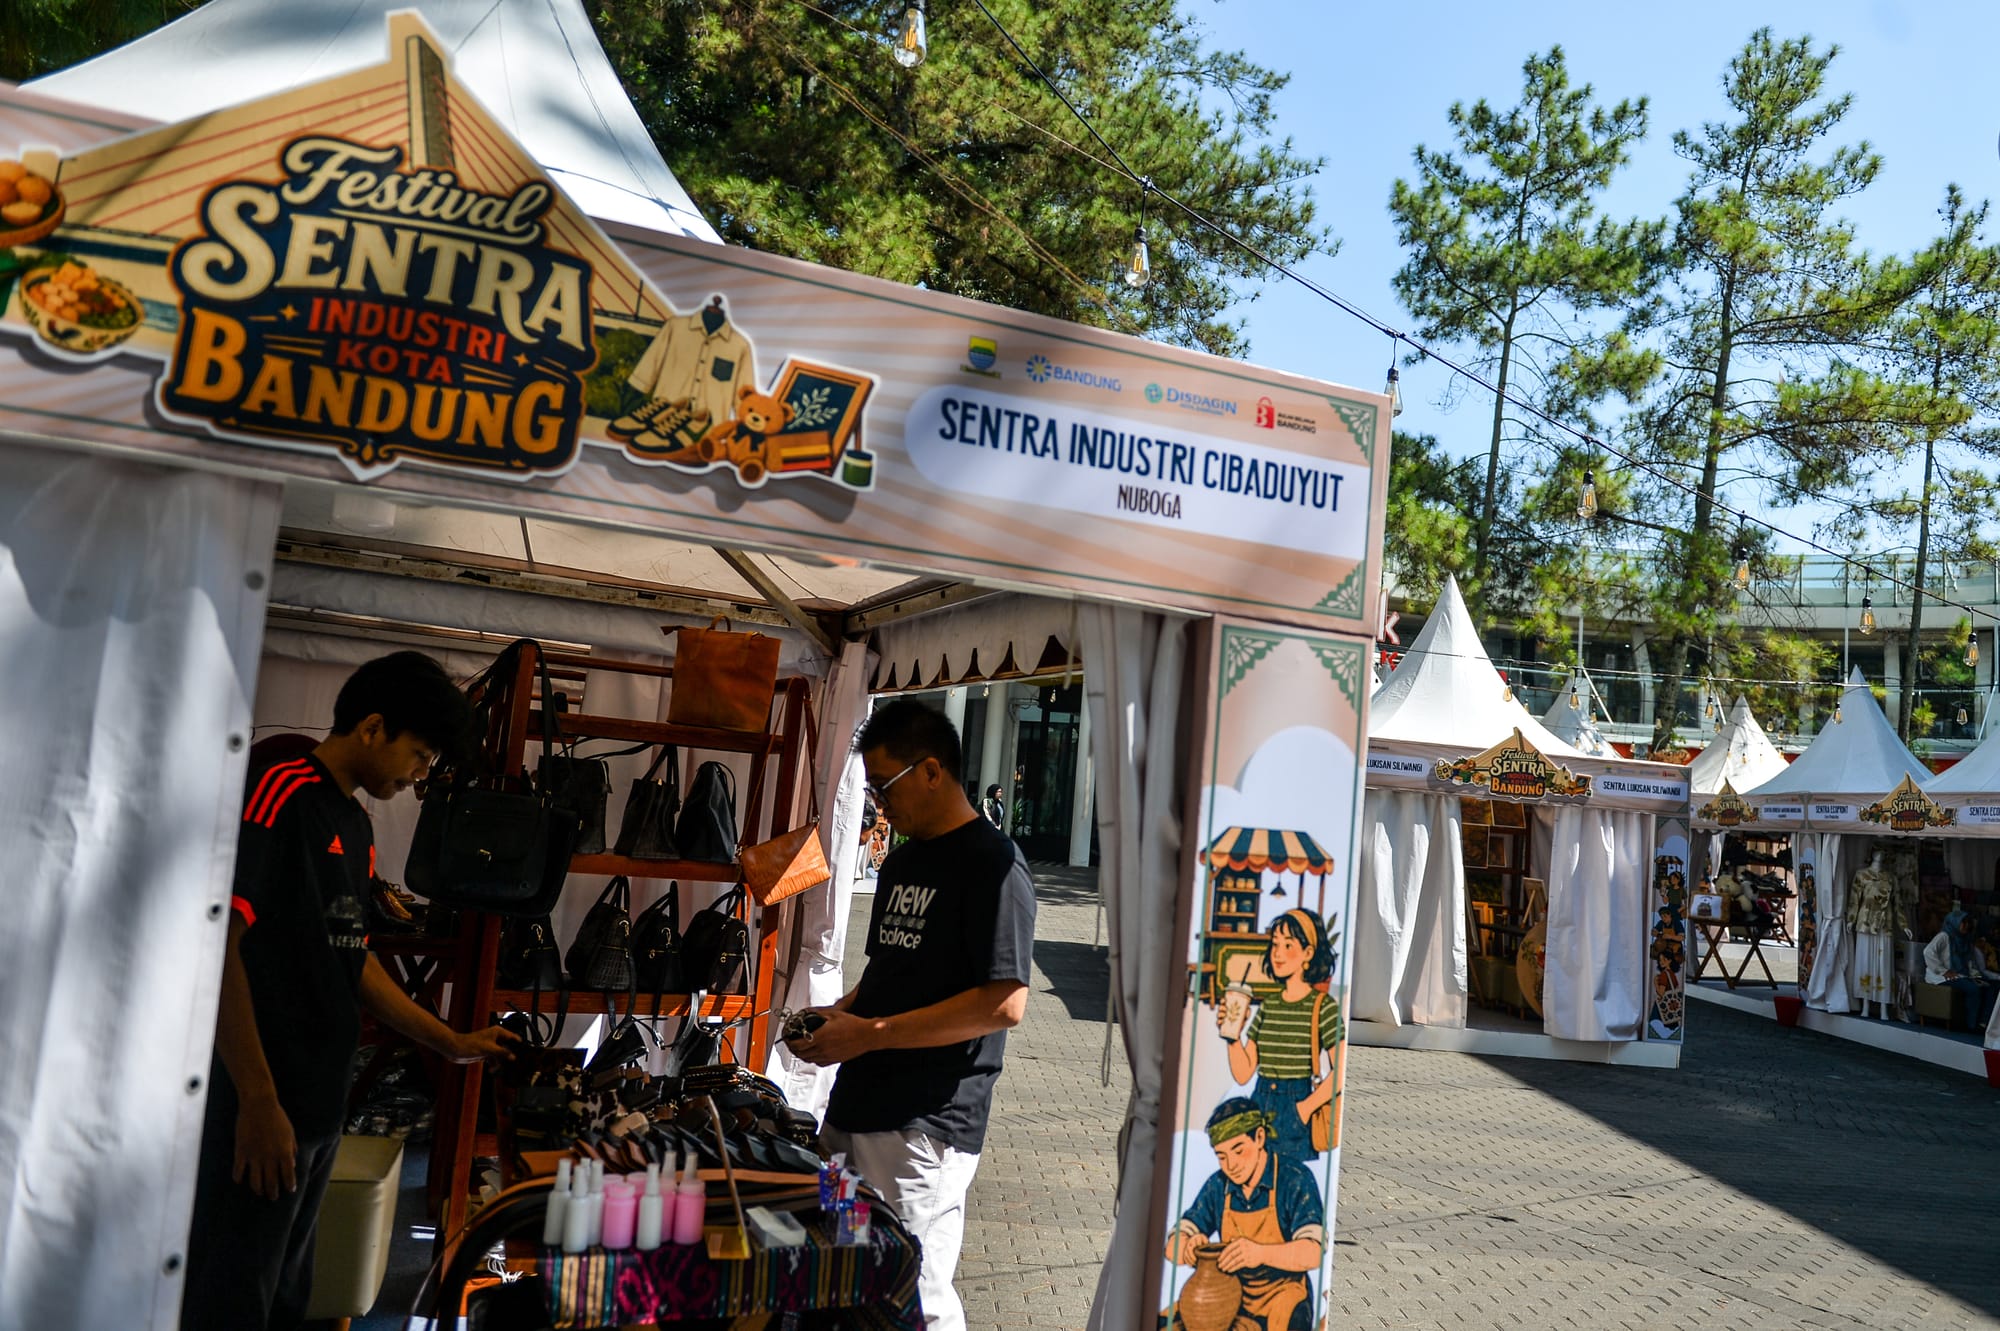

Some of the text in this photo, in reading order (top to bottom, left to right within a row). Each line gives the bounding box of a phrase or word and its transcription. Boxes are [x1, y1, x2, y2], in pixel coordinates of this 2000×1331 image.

[281, 137, 548, 243] Festival
[181, 185, 587, 351] SENTRA
[307, 298, 507, 364] INDUSTRI
[337, 339, 453, 383] KOTA
[175, 308, 566, 454] BANDUNG
[1054, 366, 1122, 392] BANDUNG
[1277, 420, 1316, 434] BANDUNG
[939, 397, 1344, 512] SENTRA INDUSTRI CIBADUYUT
[1117, 484, 1181, 520] NUBOGA
[1490, 757, 1546, 777] SENTRA
[1491, 777, 1543, 796] BANDUNG
[1603, 781, 1626, 791] SENTRA
[1891, 800, 1925, 815] SENTRA
[1969, 806, 1989, 816] SENTRA
[886, 884, 936, 916] new
